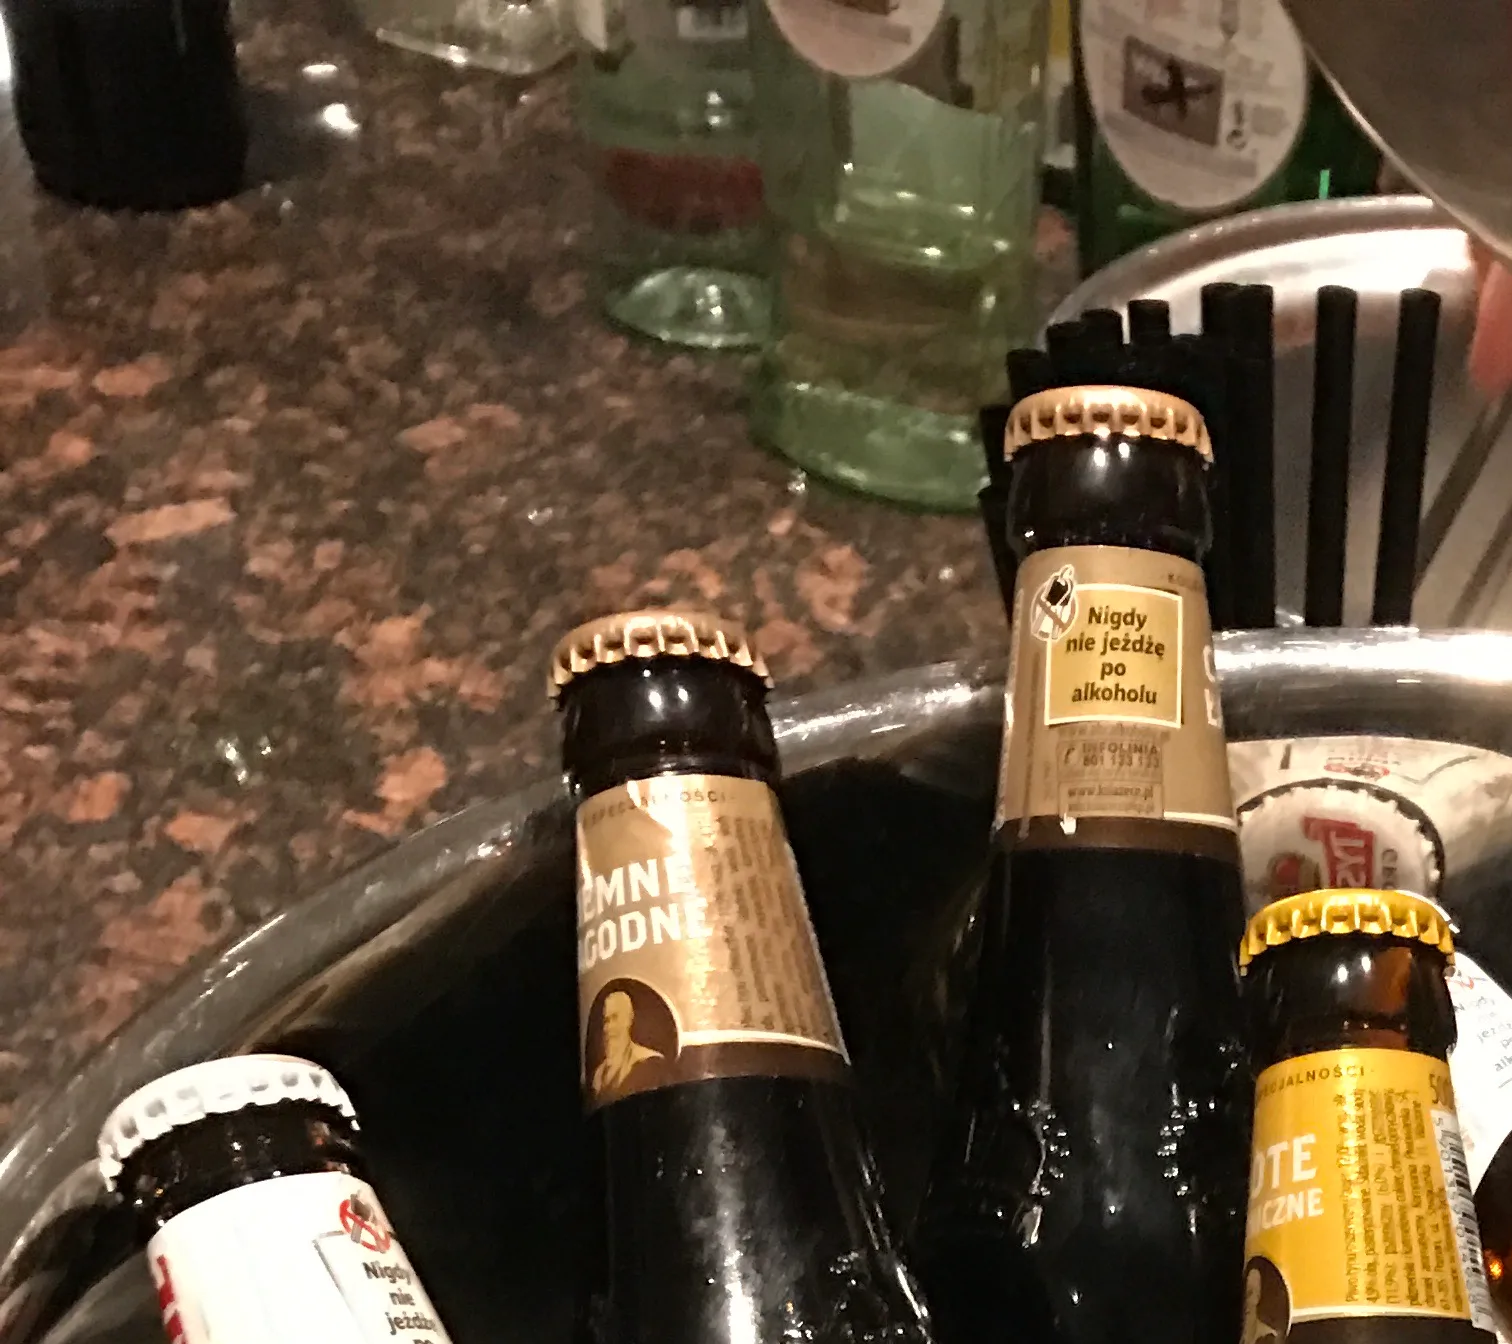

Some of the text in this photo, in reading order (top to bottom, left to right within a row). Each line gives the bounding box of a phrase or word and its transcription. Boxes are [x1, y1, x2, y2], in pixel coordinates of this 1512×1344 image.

[1088, 607, 1147, 630] Nigdy
[1065, 631, 1166, 661] nie jeżdżę
[1100, 661, 1127, 680] po
[1071, 682, 1158, 705] alkoholu
